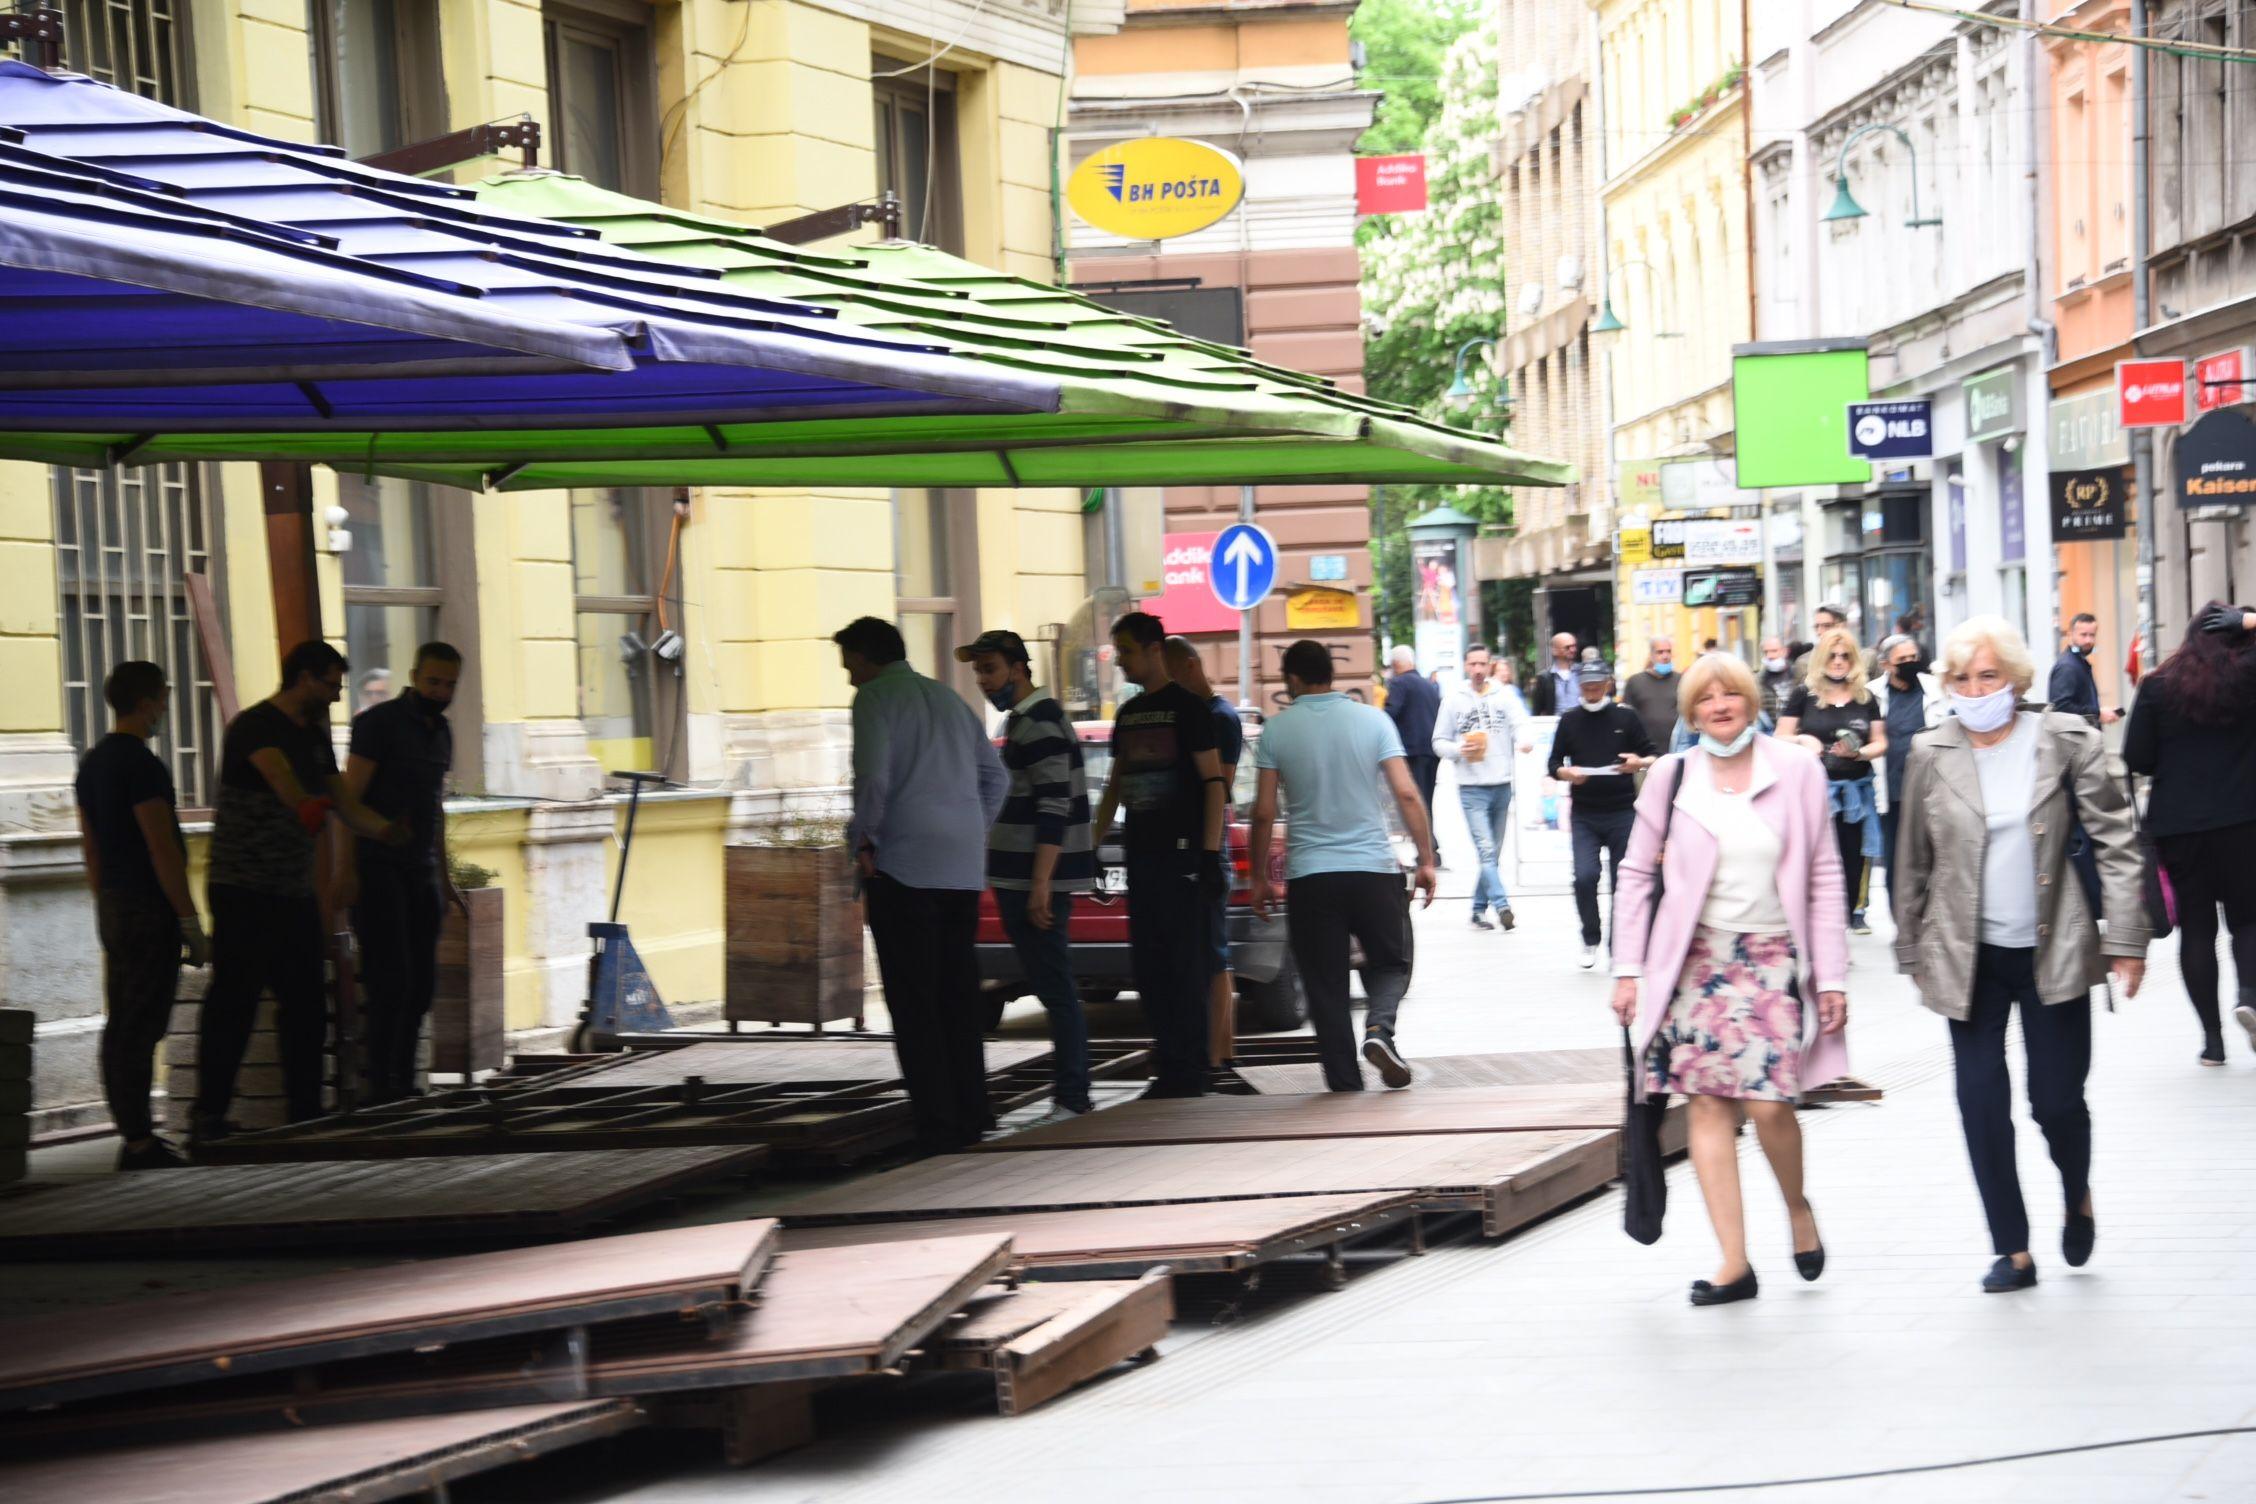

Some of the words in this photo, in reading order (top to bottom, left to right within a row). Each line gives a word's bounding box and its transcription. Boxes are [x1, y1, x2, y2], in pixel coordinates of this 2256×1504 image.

[1129, 183, 1154, 203] BH
[1161, 174, 1220, 200] POŠTA
[1887, 419, 1927, 438] NLB
[1164, 566, 1205, 585] ank
